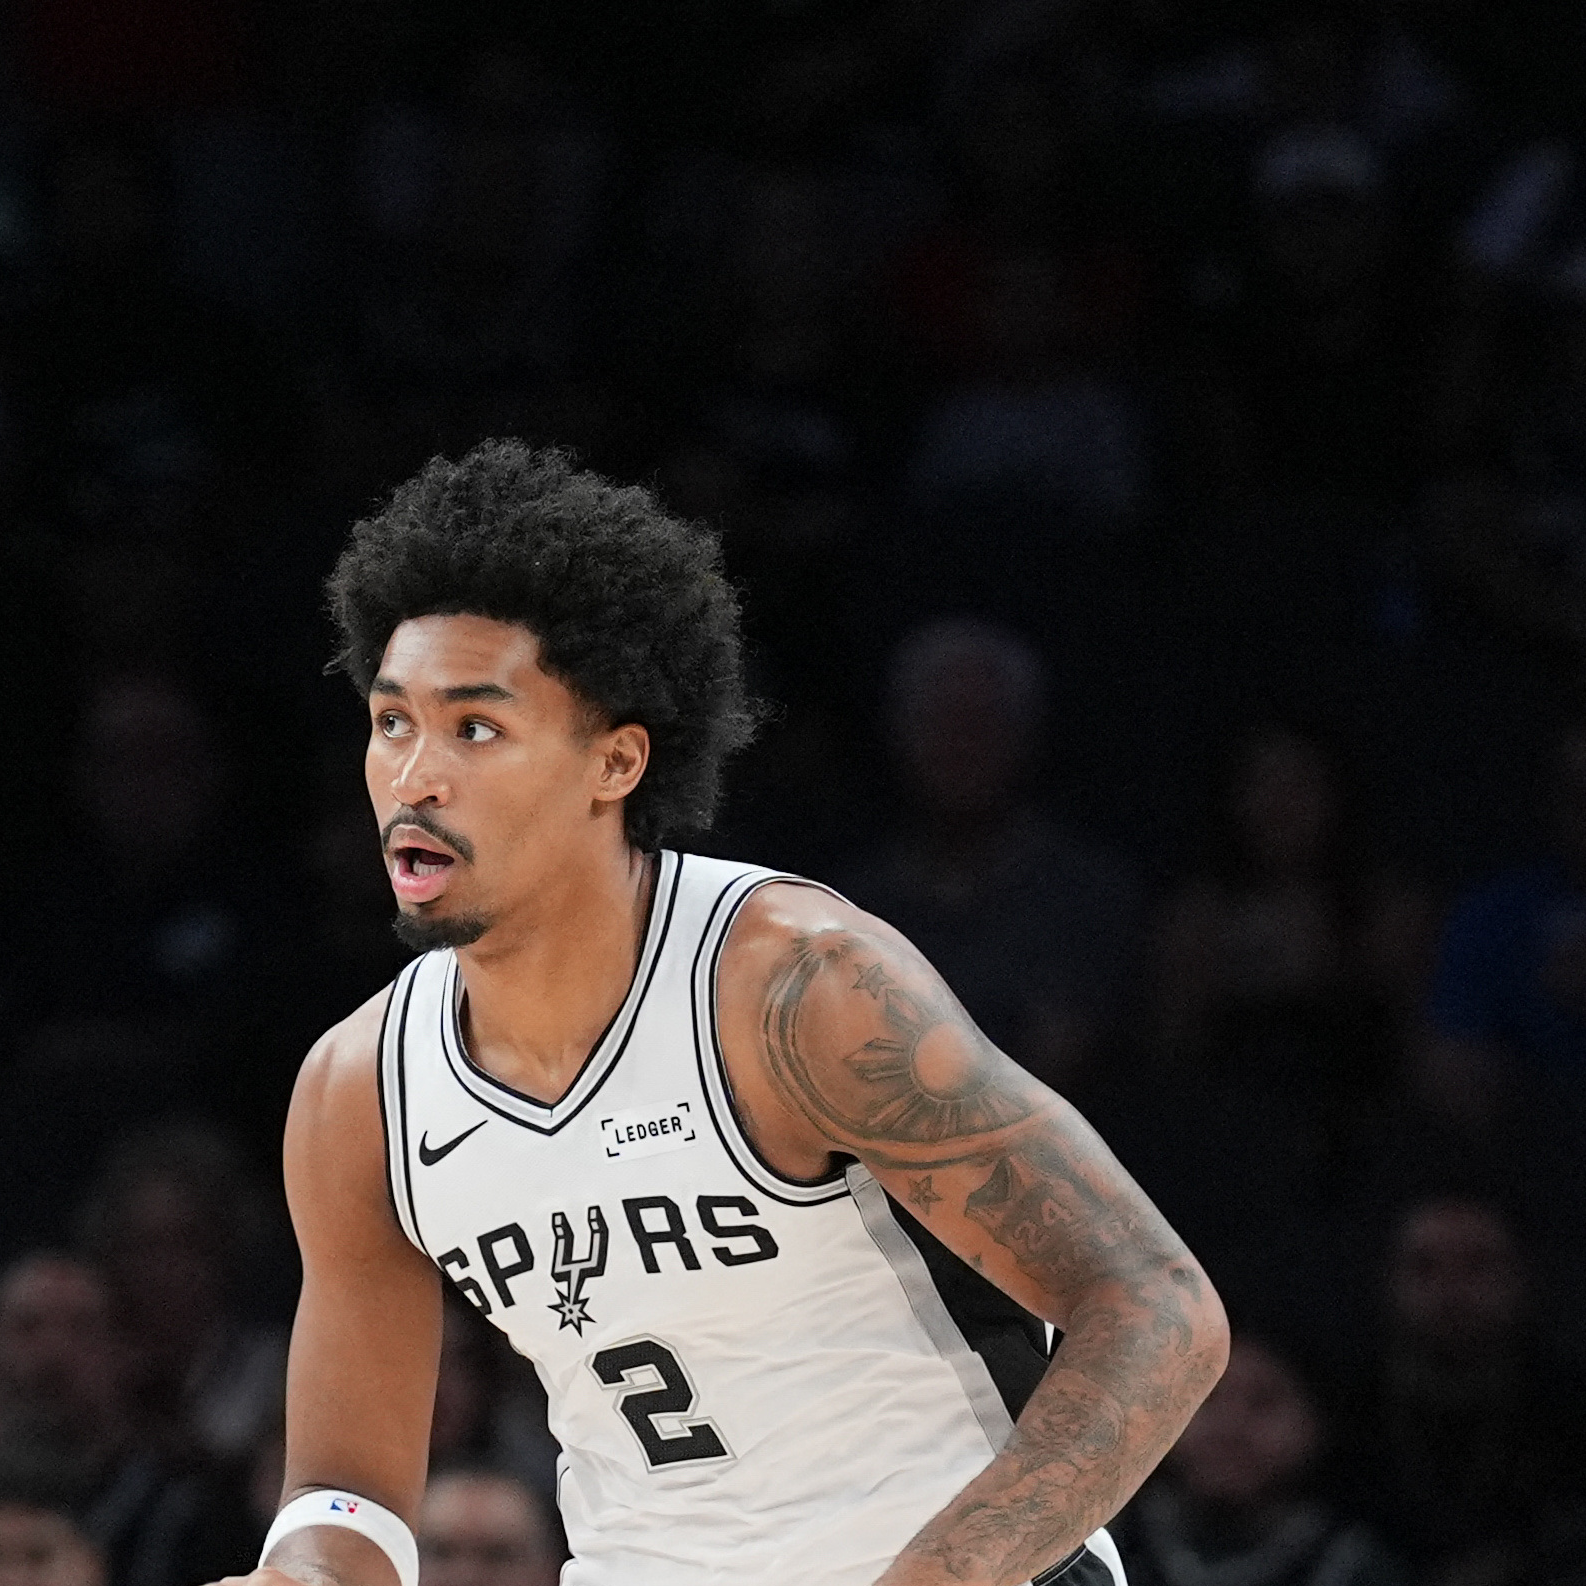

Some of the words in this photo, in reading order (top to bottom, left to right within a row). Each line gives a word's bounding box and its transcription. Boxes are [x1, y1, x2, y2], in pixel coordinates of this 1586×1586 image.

[614, 1115, 683, 1145] LEDGER
[436, 1194, 780, 1320] SPURS
[587, 1334, 736, 1472] 2
